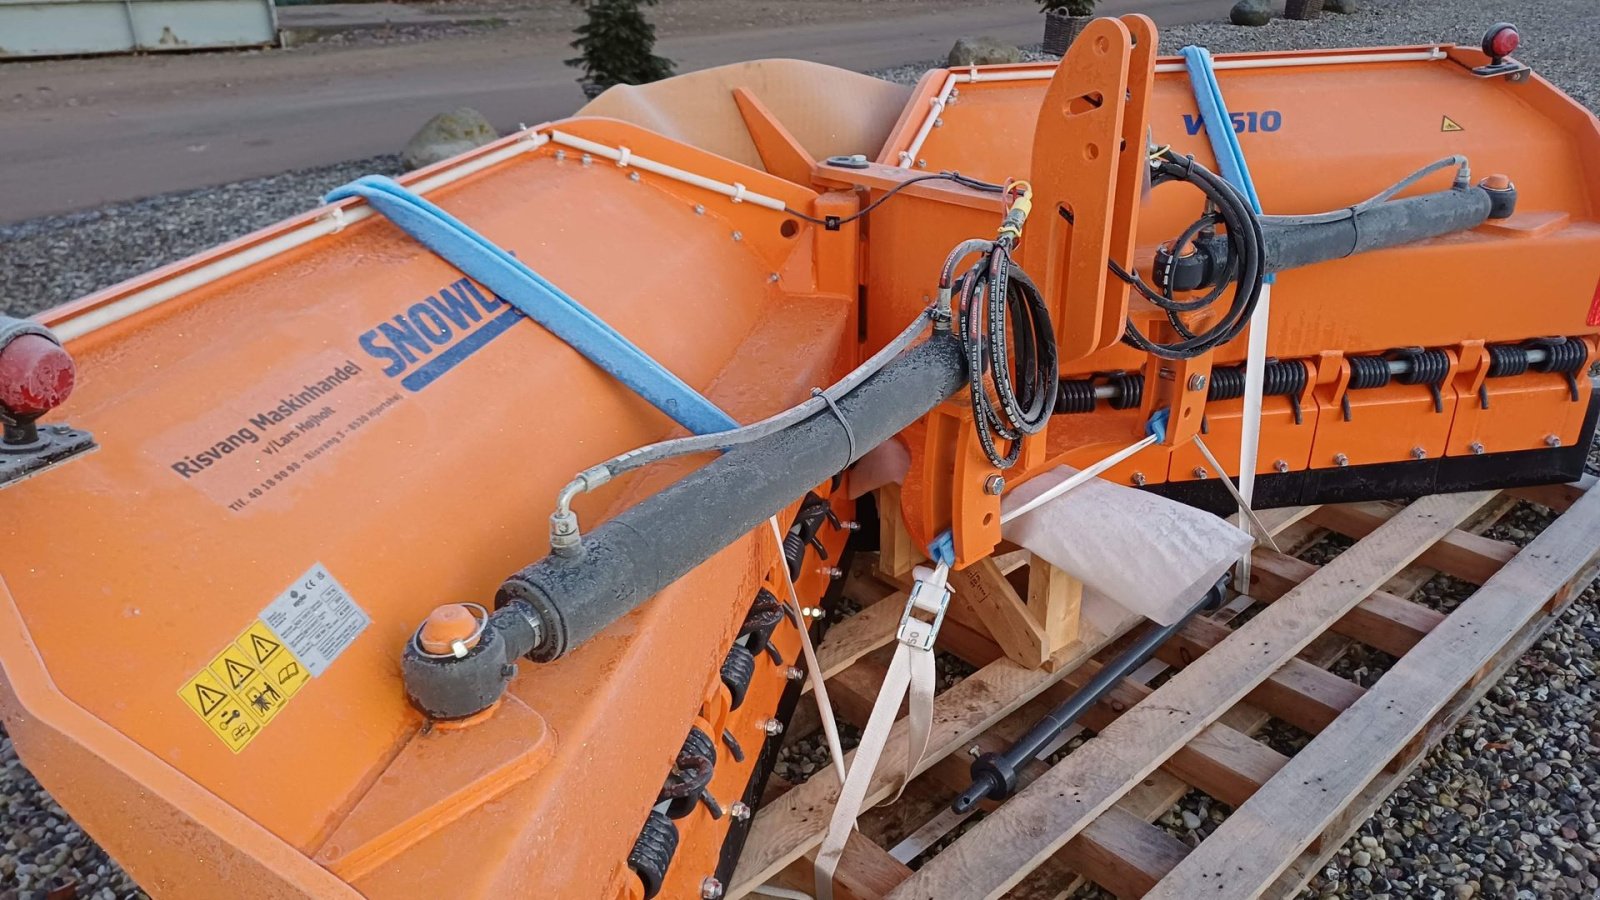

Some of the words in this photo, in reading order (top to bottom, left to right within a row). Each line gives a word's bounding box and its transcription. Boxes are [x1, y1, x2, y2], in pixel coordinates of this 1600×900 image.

[1182, 110, 1282, 136] V510
[170, 427, 260, 479] Risvang
[249, 360, 362, 431] Maskinhandel
[262, 430, 299, 456] v/Lars
[248, 488, 263, 499] 40
